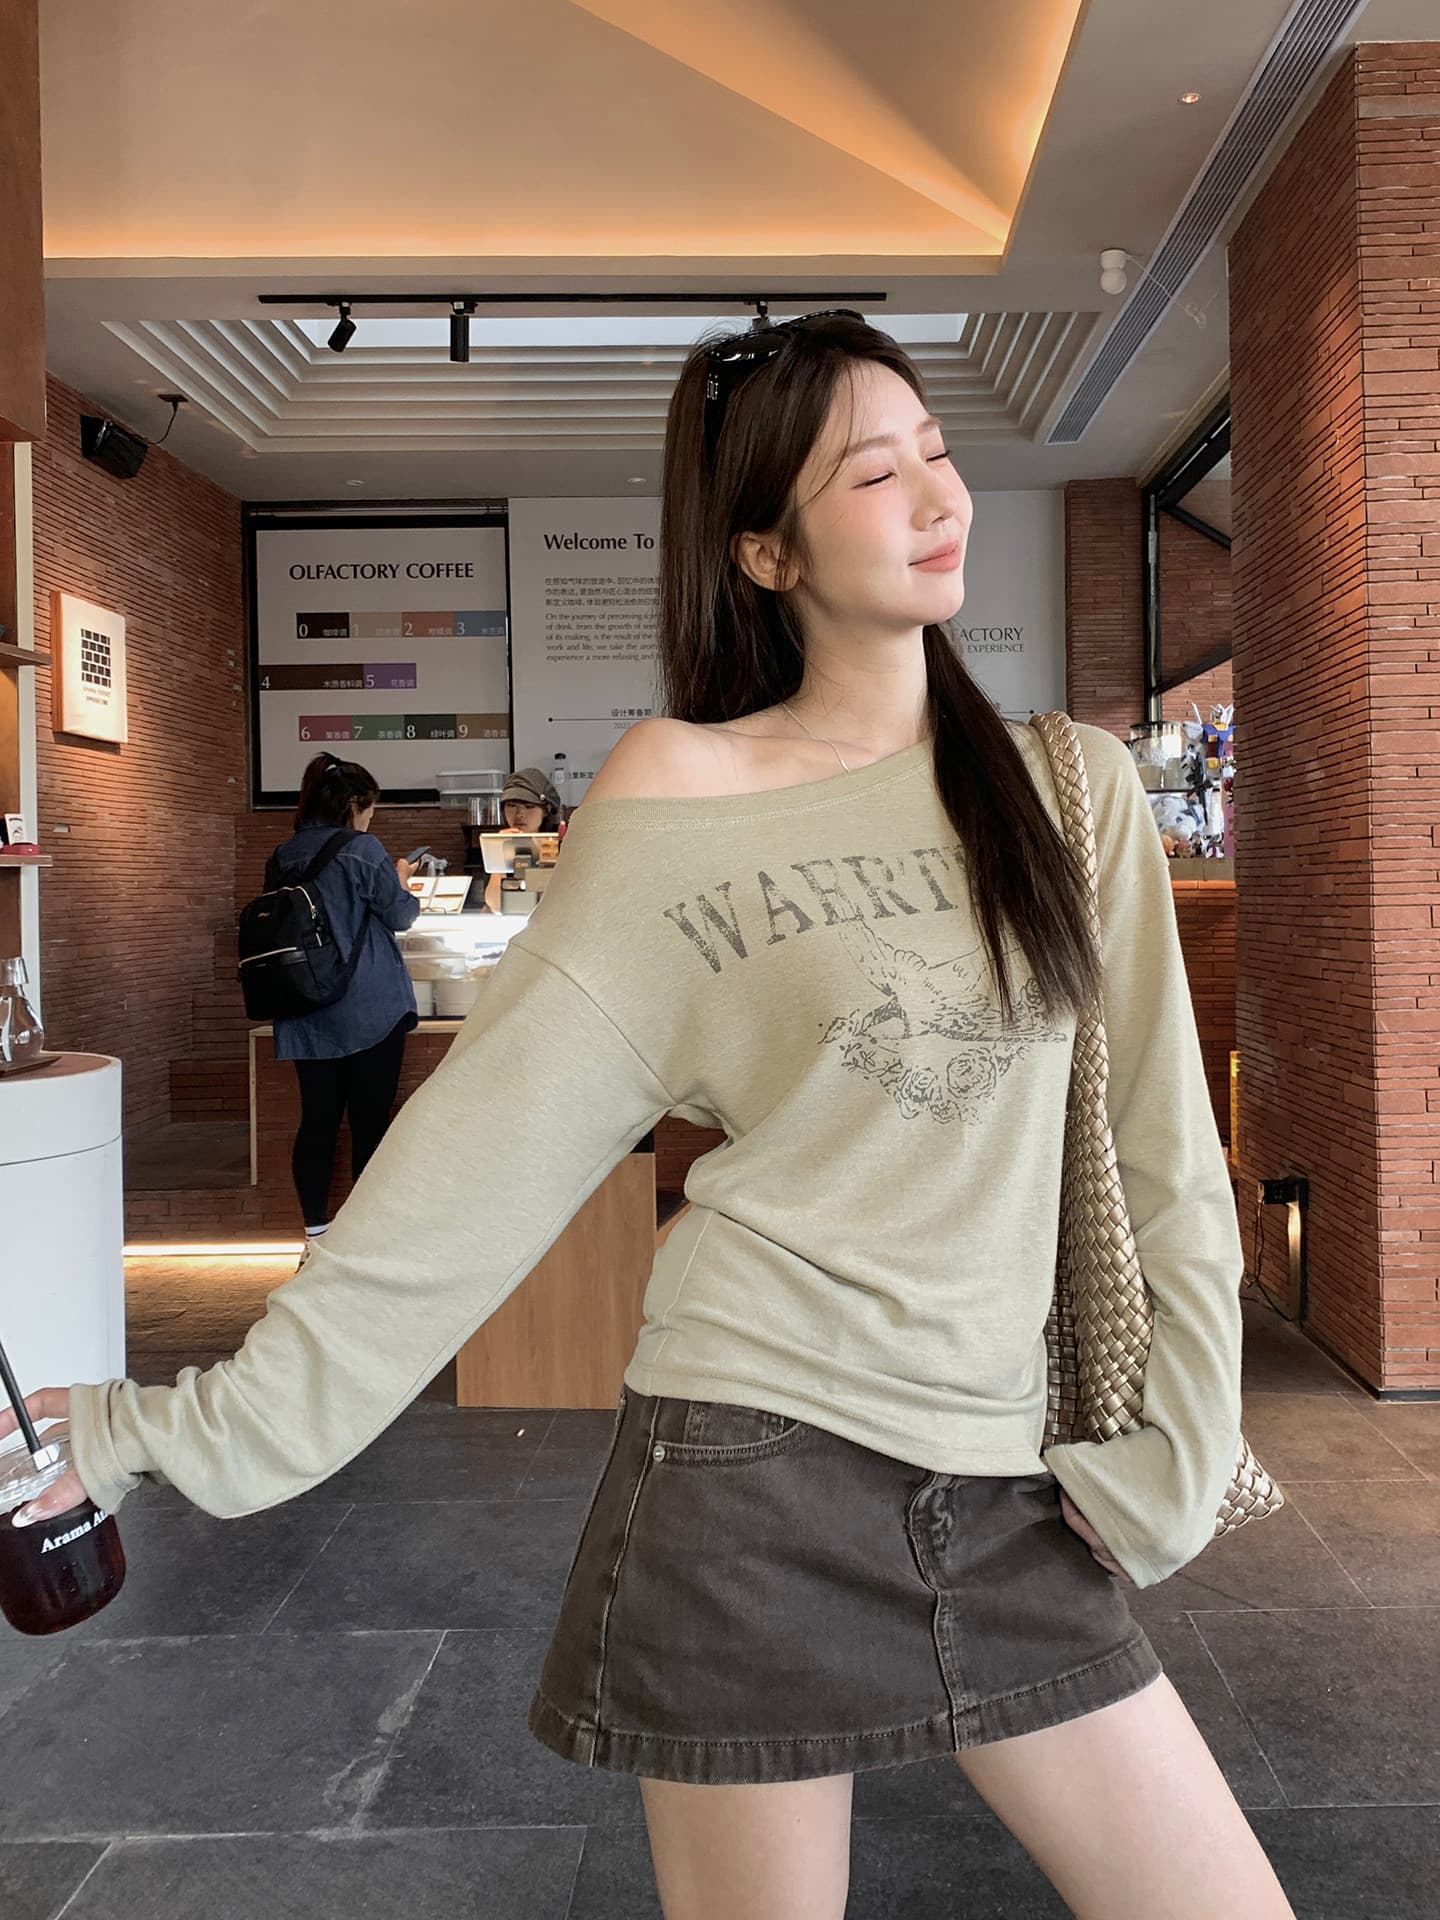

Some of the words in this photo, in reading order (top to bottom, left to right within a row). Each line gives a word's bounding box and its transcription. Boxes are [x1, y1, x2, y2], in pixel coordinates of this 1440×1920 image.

[544, 532, 628, 550] Welcome
[633, 533, 655, 550] To
[289, 563, 400, 581] OLFACTORY
[405, 562, 475, 579] COFFEE
[299, 624, 309, 638] 0
[404, 622, 414, 636] 2
[457, 622, 466, 636] 3
[967, 643, 1025, 654] EXPERIENCE
[261, 676, 271, 689] 4
[365, 674, 376, 688] 5
[301, 726, 311, 740] 6
[353, 725, 364, 739] 7
[406, 725, 416, 739] 8
[458, 724, 468, 738] 9
[40, 1520, 93, 1555] Arama
